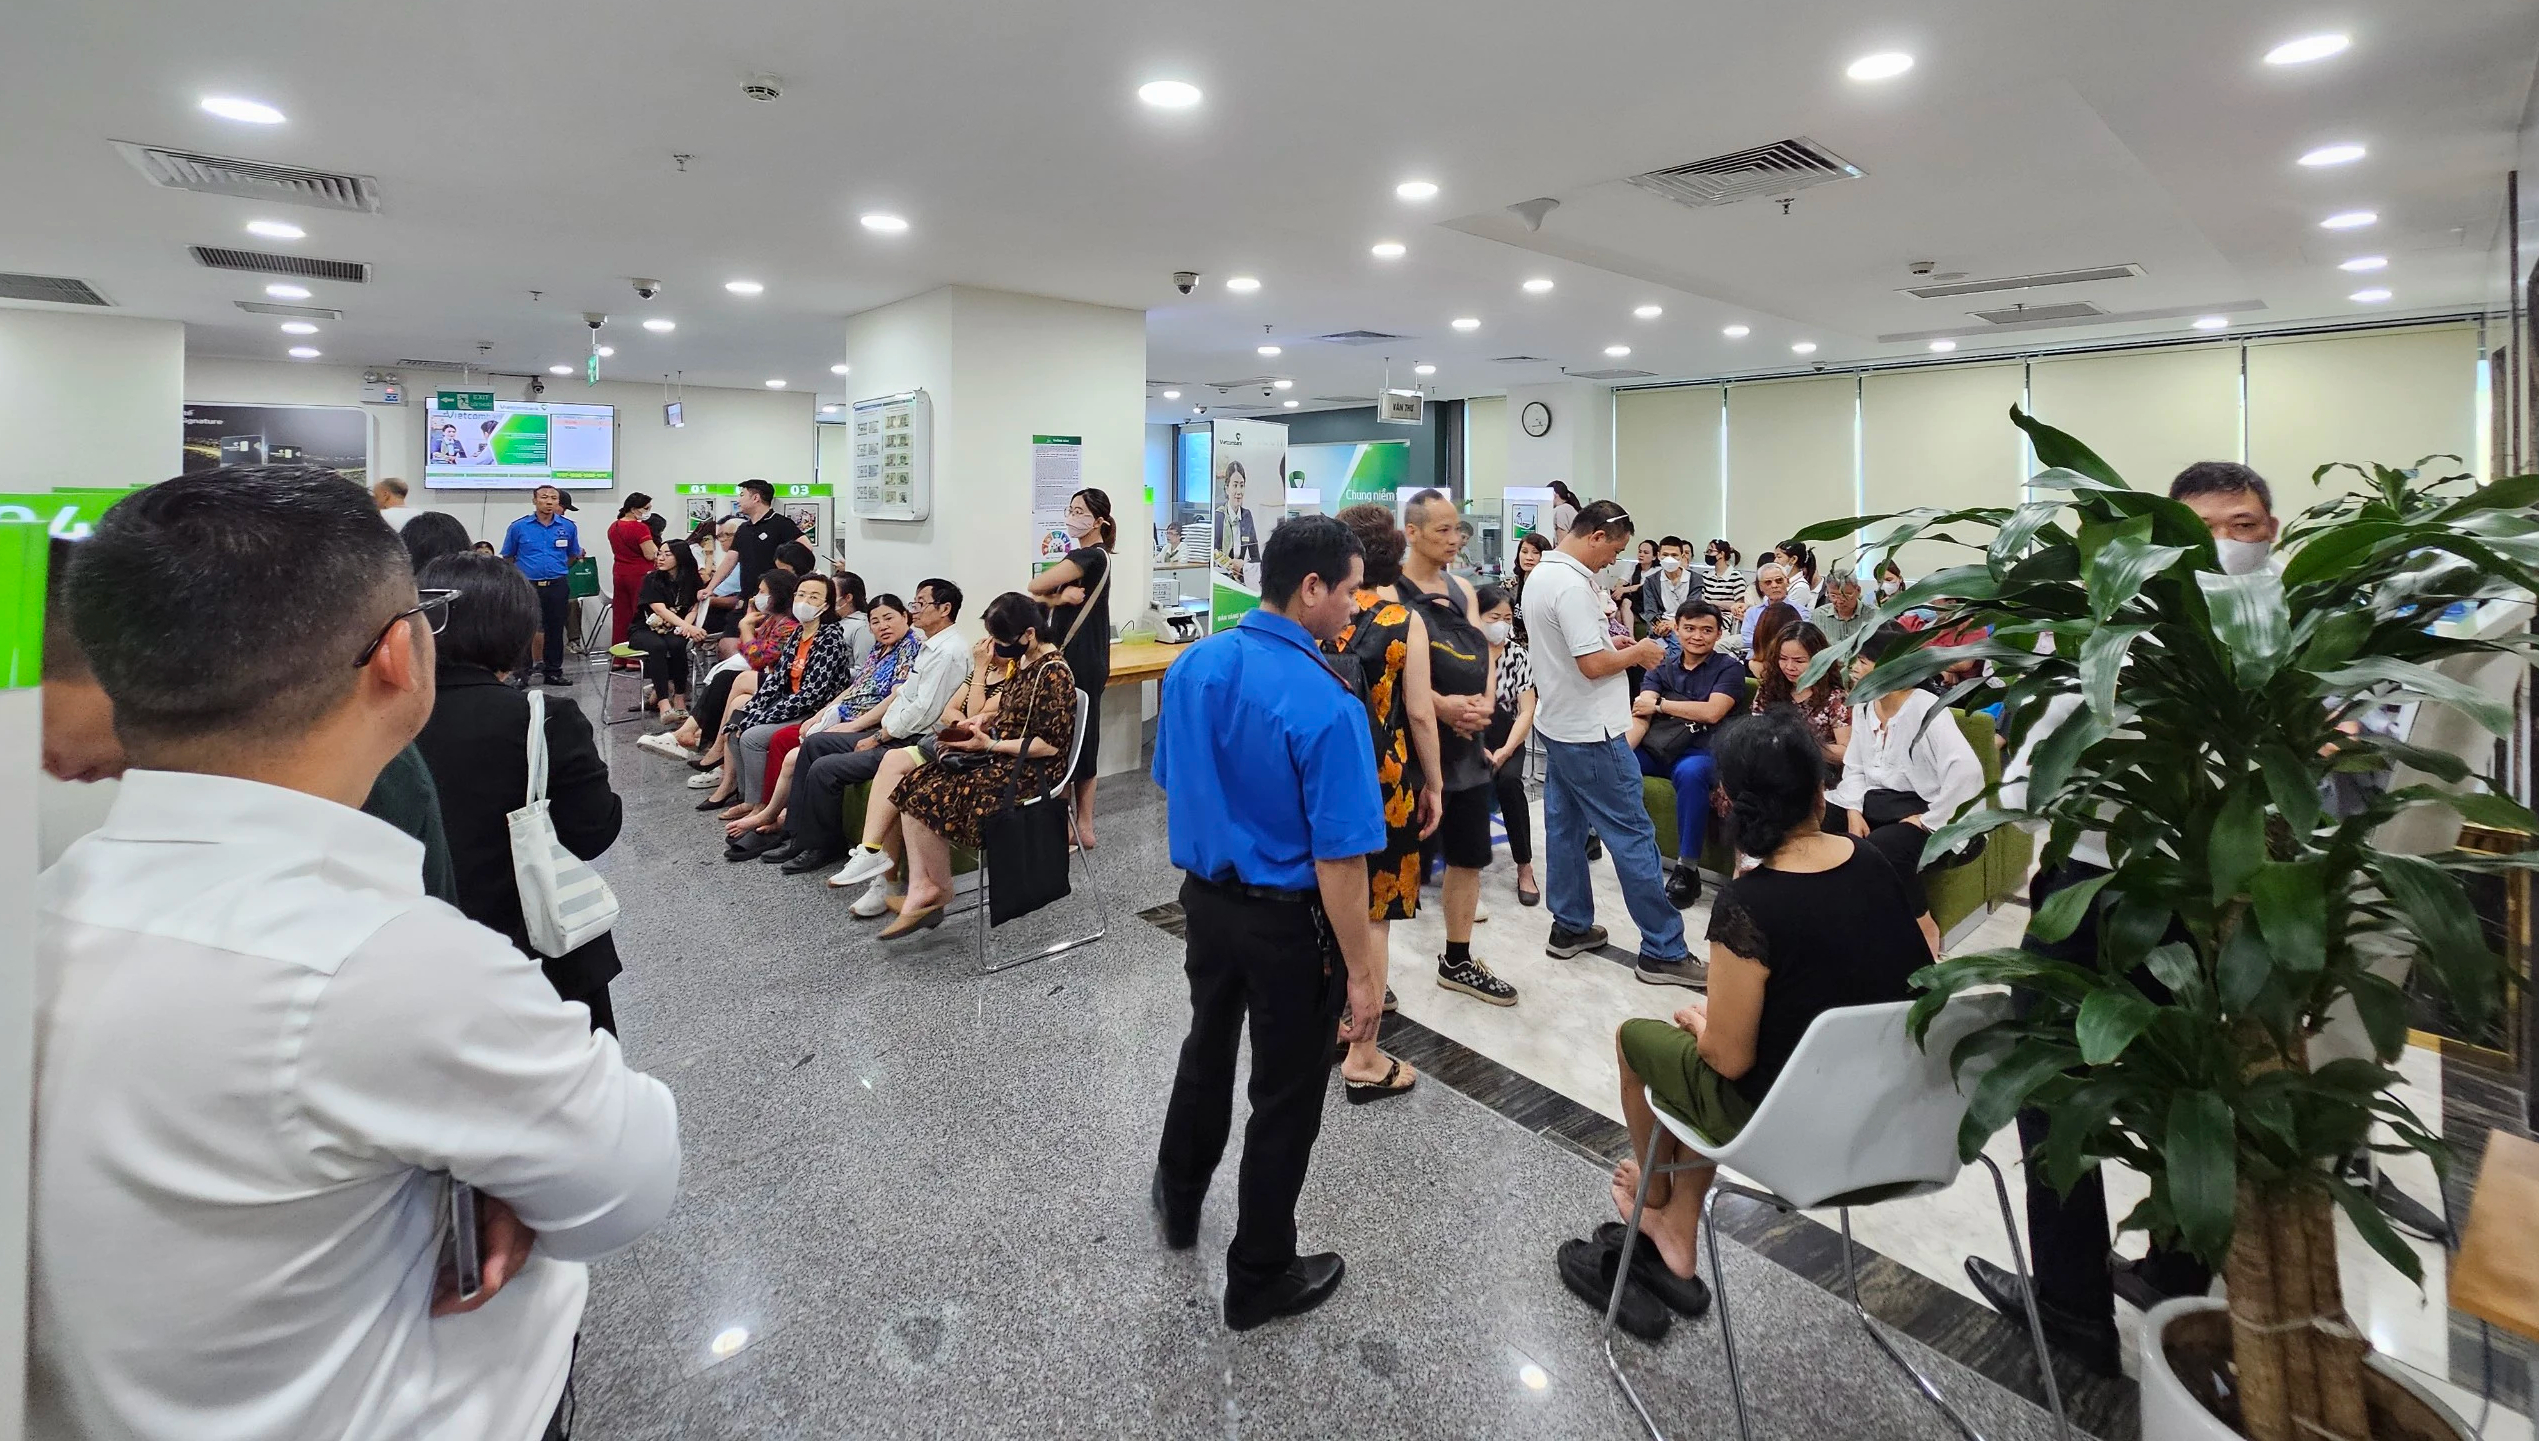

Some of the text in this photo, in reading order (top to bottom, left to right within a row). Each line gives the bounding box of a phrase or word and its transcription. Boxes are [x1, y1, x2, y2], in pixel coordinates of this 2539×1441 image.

[690, 485, 707, 494] 01
[790, 485, 810, 495] 03
[1345, 489, 1372, 502] Chung
